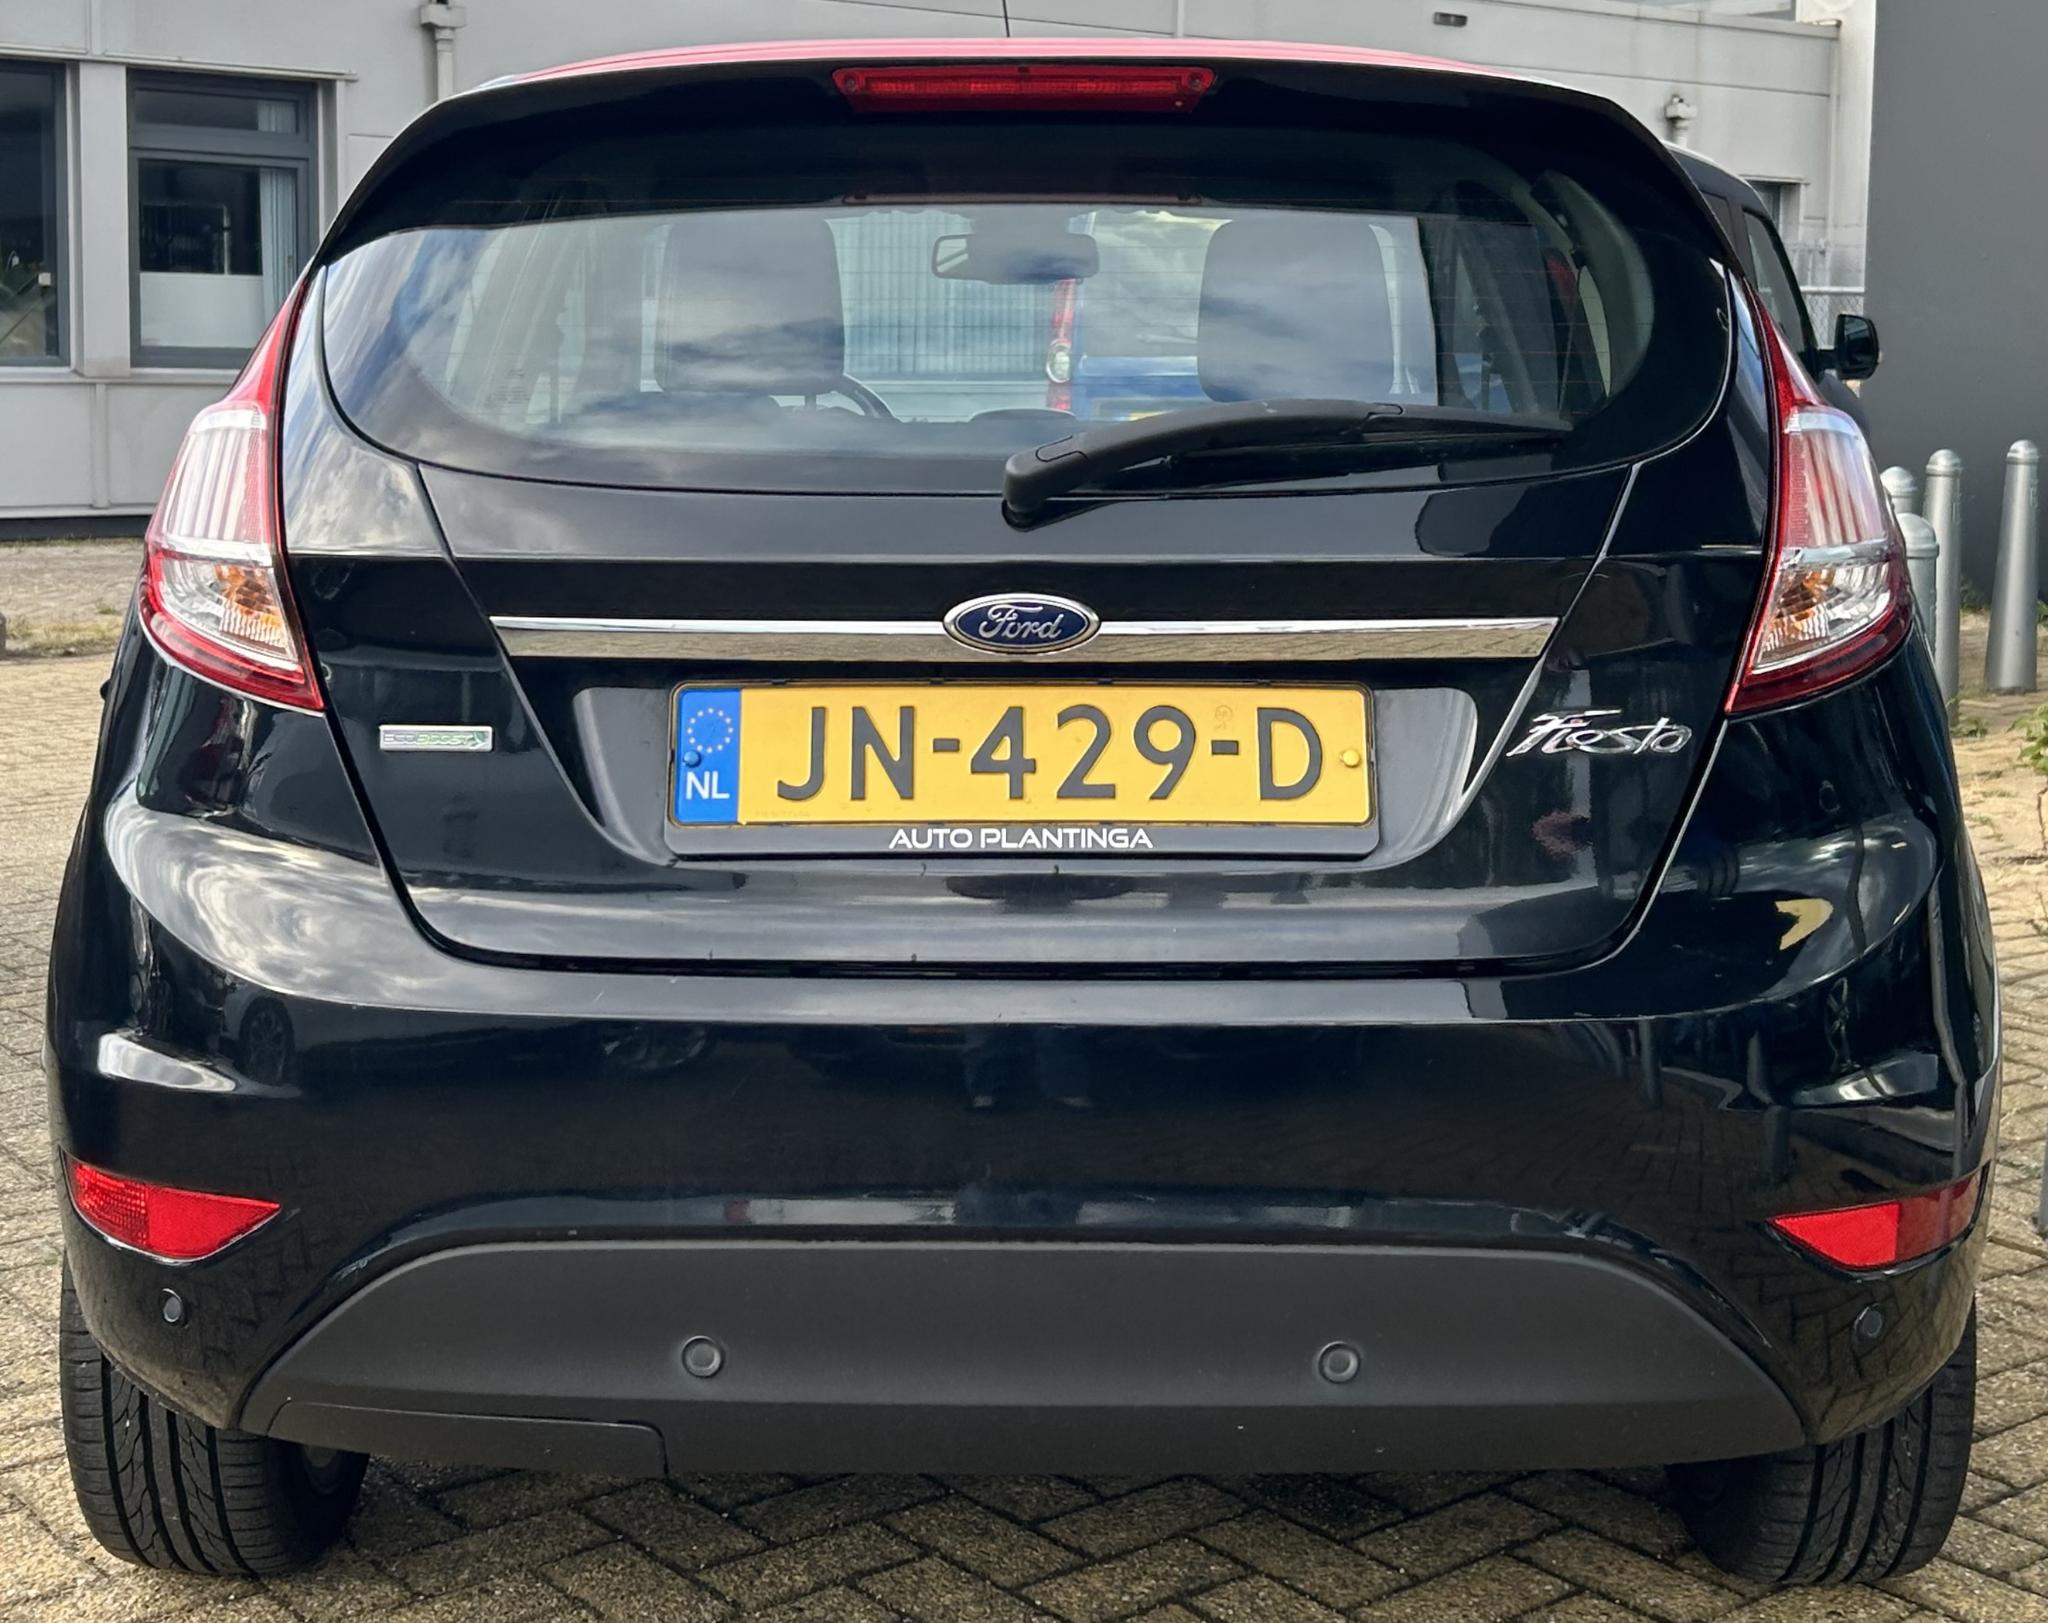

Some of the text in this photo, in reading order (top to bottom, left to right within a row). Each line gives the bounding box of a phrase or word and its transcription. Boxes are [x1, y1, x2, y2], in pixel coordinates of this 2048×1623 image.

[979, 605, 1064, 638] Ford
[1506, 709, 1692, 757] Fiesta
[777, 705, 1323, 801] JN-429-D
[686, 772, 730, 799] NL
[889, 828, 1154, 849] AUTO PLANTINGA
